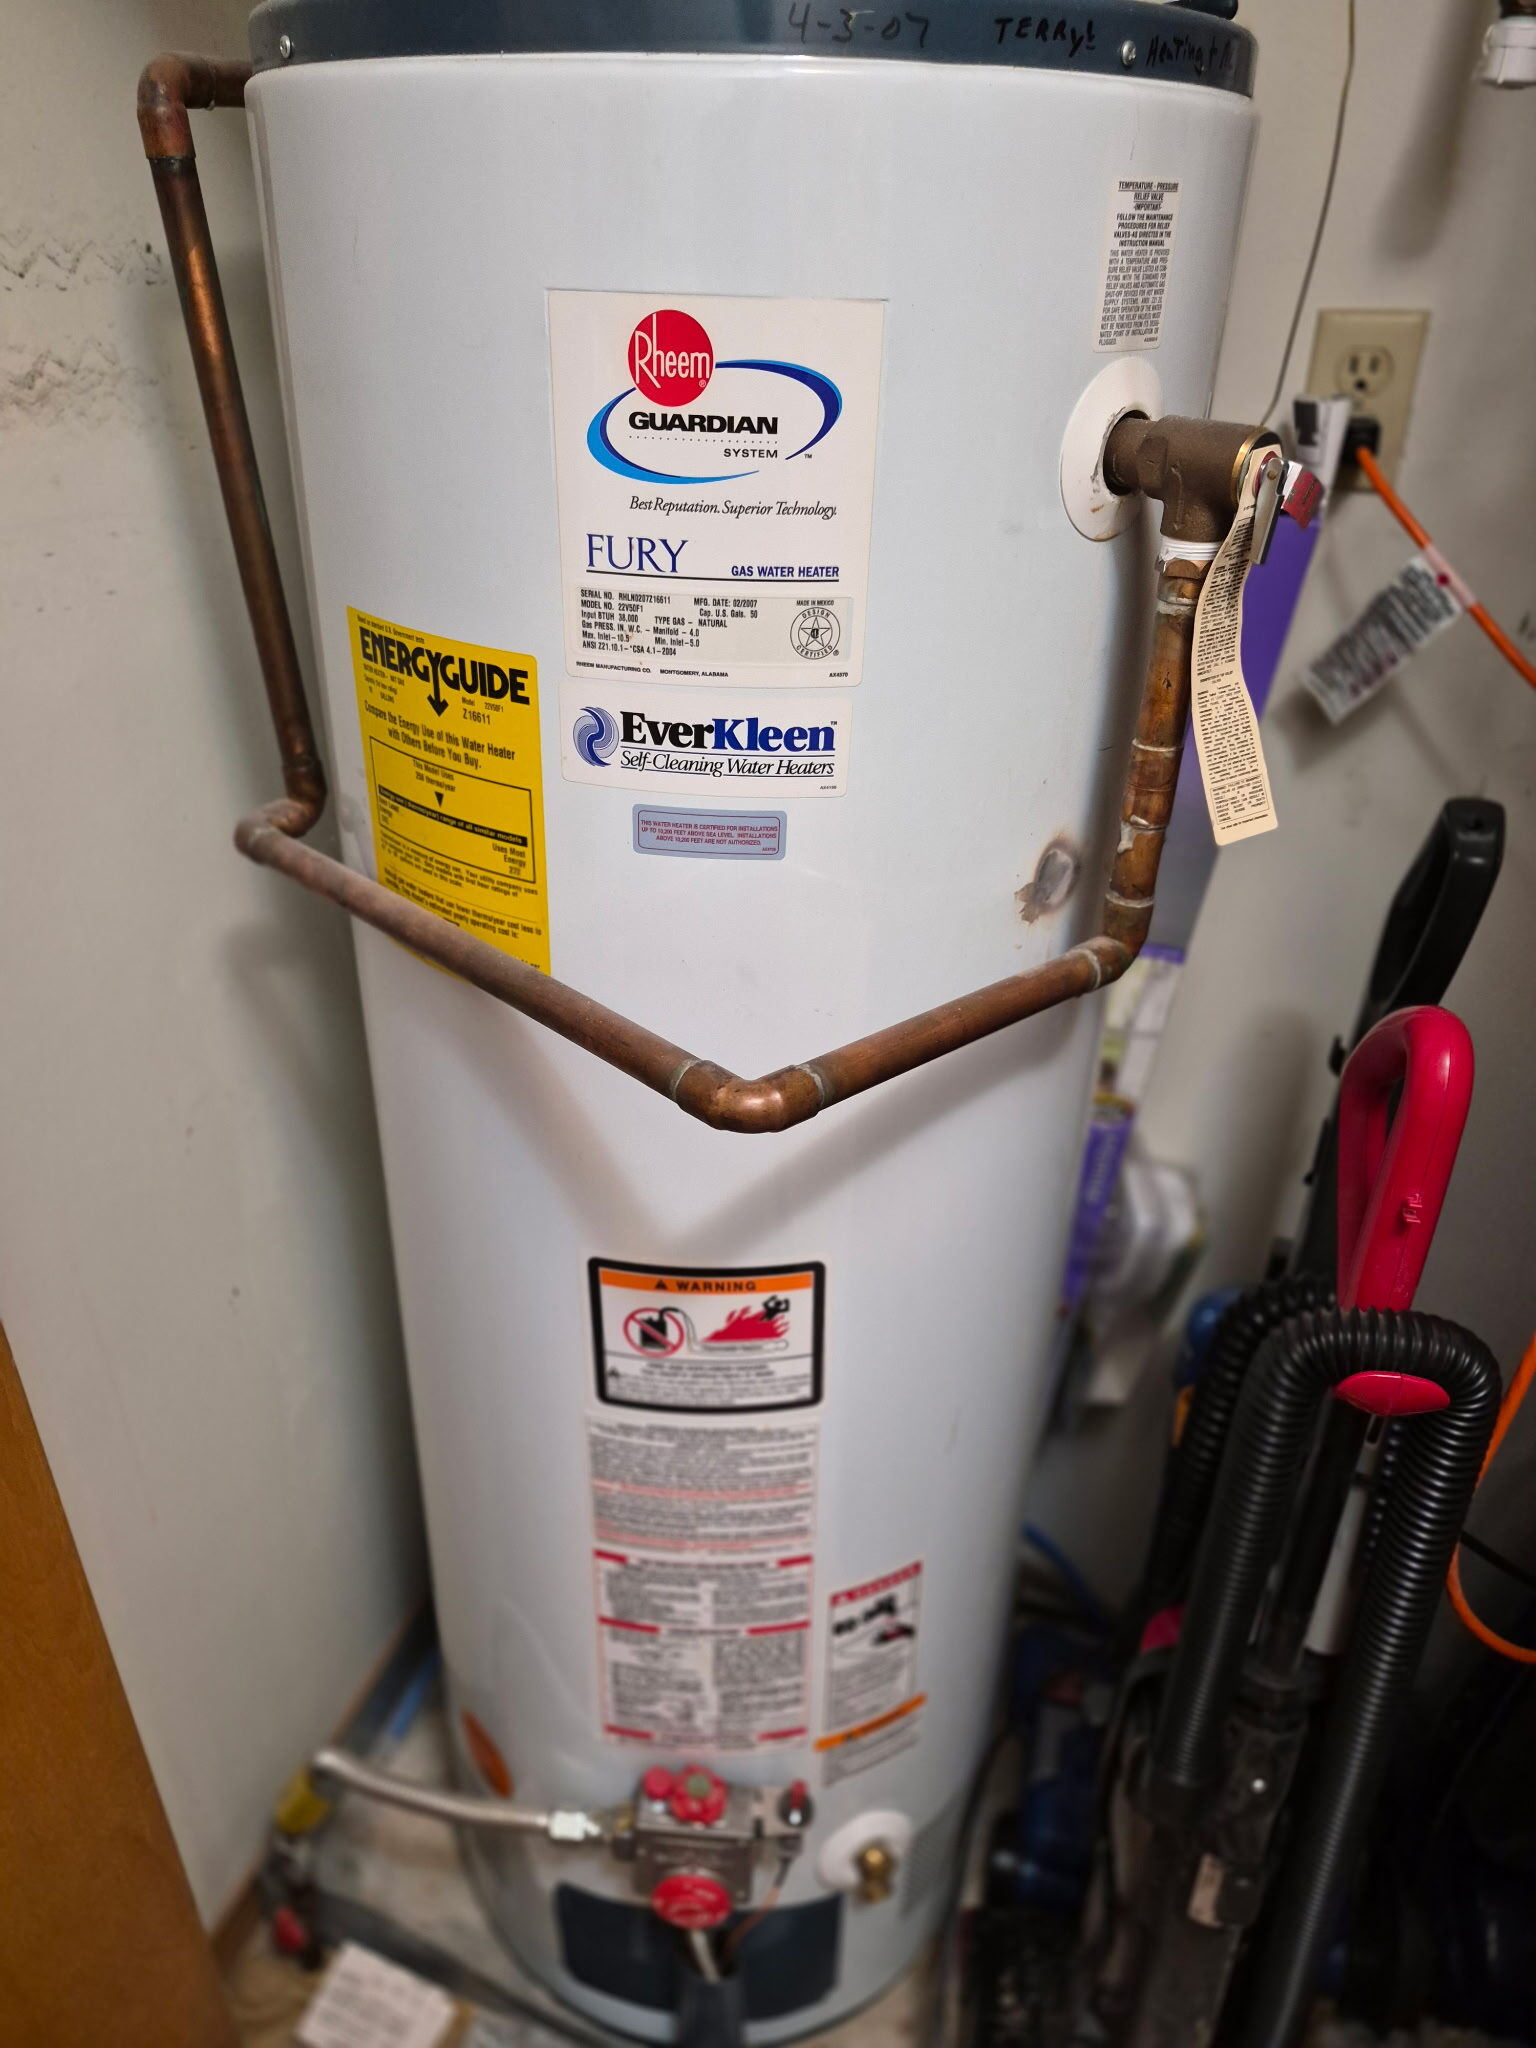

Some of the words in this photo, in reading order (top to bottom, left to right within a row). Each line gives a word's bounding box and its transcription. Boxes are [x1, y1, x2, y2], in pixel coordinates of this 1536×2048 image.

[788, 2, 930, 48] 4-3-07
[1119, 181, 1153, 190] TEMPERATURE
[1156, 182, 1179, 191] PRESSURE
[1133, 192, 1150, 201] RELIEF
[1150, 192, 1164, 201] VALVE
[1145, 213, 1173, 221] MAINTENANCE
[1118, 239, 1148, 247] INSTRUCTION
[633, 311, 710, 389] Rheem
[628, 411, 779, 435] GUARDIAN
[723, 448, 779, 459] SYSTEM
[629, 495, 653, 511] Best
[653, 496, 720, 516] Reputation.
[721, 499, 773, 517] Superior
[775, 500, 837, 520] Technology.
[586, 533, 689, 574] FURY
[731, 565, 754, 578] GAS
[757, 565, 795, 578] WATER
[798, 566, 840, 578] HEATER
[580, 589, 601, 599] SERIAL
[603, 591, 614, 600] NO.
[580, 599, 602, 609] MODEL
[603, 601, 614, 611] NO.
[618, 602, 643, 613] 22V50F1
[693, 597, 710, 607] MFG.
[712, 598, 731, 607] DATE:
[733, 599, 758, 608] 02/2007
[581, 610, 596, 620] Input
[598, 611, 615, 621] BTUH
[618, 613, 638, 623] 38,000
[699, 608, 713, 618] Cap.
[715, 609, 728, 618] U.S.
[730, 609, 746, 618] Gals.
[750, 610, 758, 618] 50
[802, 608, 831, 619] DESIGN
[581, 620, 592, 629] Gas
[594, 621, 615, 631] PRESS.
[628, 624, 642, 633] W.C.
[653, 626, 679, 636] Manifold
[689, 628, 700, 637] 4.0
[655, 616, 670, 625] TYPE
[672, 617, 685, 626] GAS
[698, 619, 728, 628] NATURAL
[582, 630, 595, 640] Max.
[655, 636, 668, 646] Min.
[582, 640, 597, 649] ANSI
[796, 645, 833, 658] CERTIFIED
[359, 626, 531, 706] ENERGYGUIDE
[595, 663, 641, 673] MANUFACTURING
[660, 668, 700, 677] MONTGOMERY,
[461, 696, 475, 706] Model
[463, 707, 491, 725] Z16611
[364, 699, 387, 720] Compare
[388, 711, 397, 725] the
[398, 715, 420, 737] Energy
[421, 723, 435, 739] Use
[436, 730, 444, 742] of
[445, 732, 460, 747] this
[461, 736, 485, 753] Water
[487, 742, 515, 760] Heater
[620, 711, 836, 751] EverKleen
[388, 728, 400, 741] with
[401, 731, 421, 750] Others
[423, 740, 446, 758] Before
[447, 748, 462, 763] You
[464, 752, 482, 770] Buy.
[413, 759, 423, 770] This
[423, 763, 440, 776] Model
[620, 750, 724, 778] Self-Cleaning
[727, 758, 773, 775] Water
[775, 759, 835, 775] Heaters
[640, 819, 652, 827] THIS
[465, 823, 473, 831] all
[474, 825, 496, 837] similar
[497, 832, 522, 844] models
[492, 842, 508, 854] Uses
[509, 846, 526, 858] Most
[503, 854, 527, 869] Energy
[676, 1280, 757, 1293] WARNING
